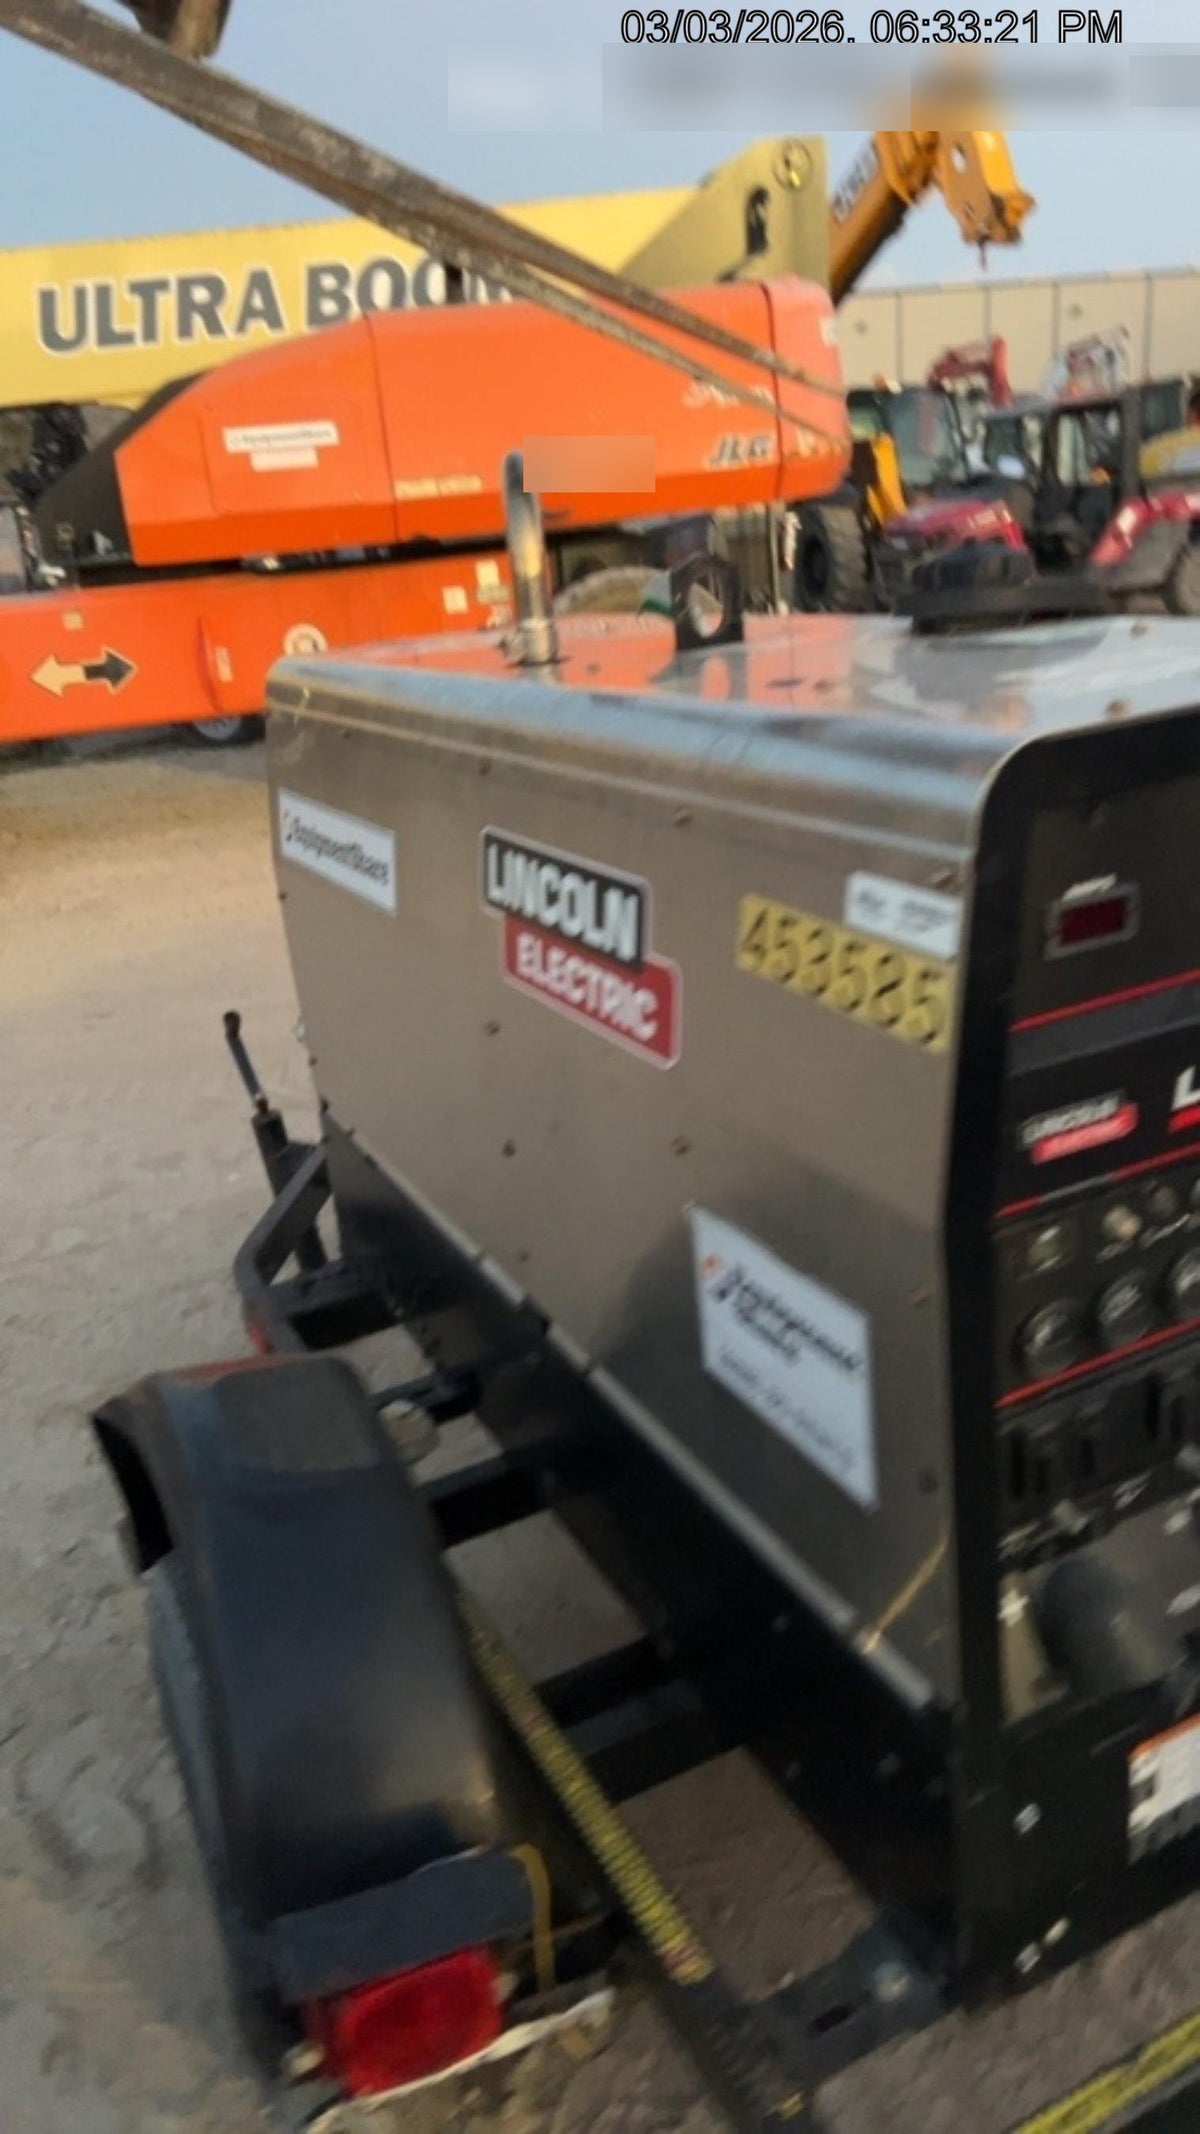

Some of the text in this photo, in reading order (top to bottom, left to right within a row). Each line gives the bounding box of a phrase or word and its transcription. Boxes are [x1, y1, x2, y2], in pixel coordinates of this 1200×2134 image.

[37, 256, 514, 355] ULTRA BOO
[486, 842, 640, 963] LINCOLN
[515, 931, 660, 1043] ELECTRIC
[740, 906, 950, 1046] 453585
